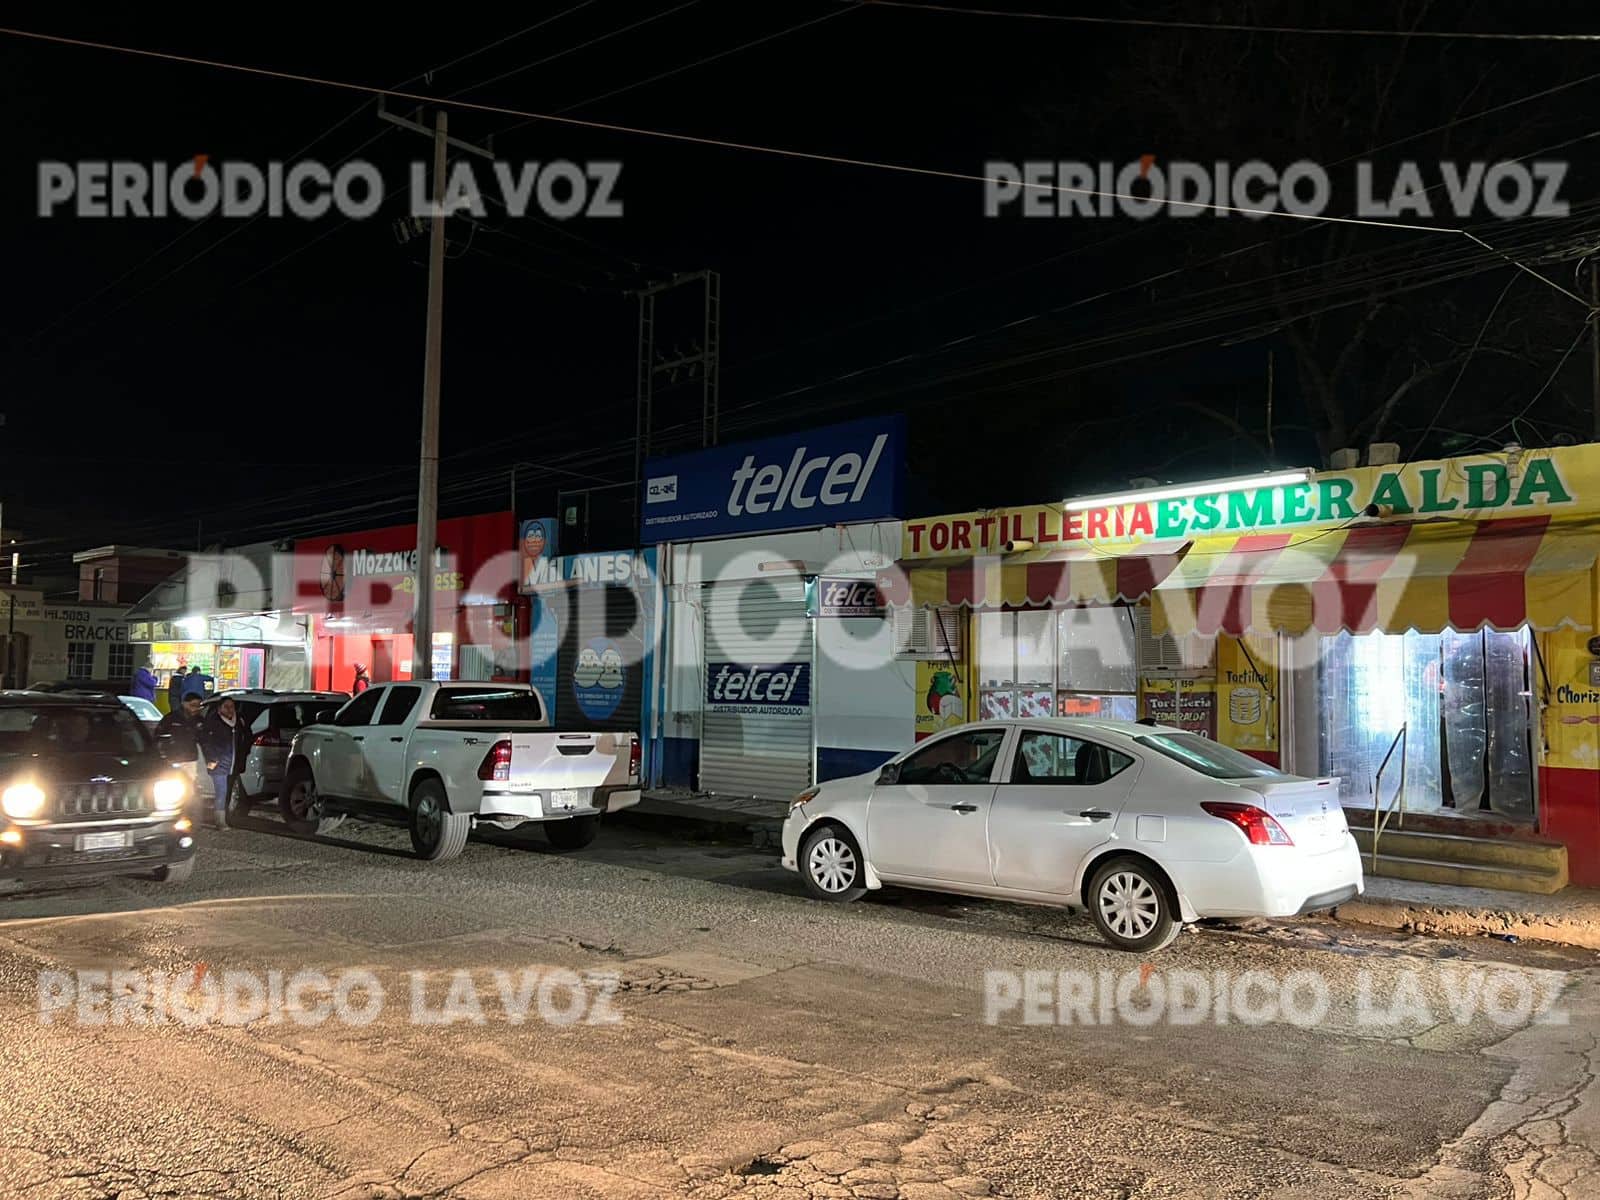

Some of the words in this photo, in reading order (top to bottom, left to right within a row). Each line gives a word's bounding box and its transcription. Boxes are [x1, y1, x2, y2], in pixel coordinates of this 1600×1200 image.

[727, 434, 888, 516] telcel
[907, 502, 1154, 553] TORTILLERIA
[1155, 458, 1572, 539] ESMERALDA
[712, 665, 802, 701] telcel
[712, 705, 758, 714] DISTRIBUIDOR
[759, 706, 803, 715] AUTORIZADO
